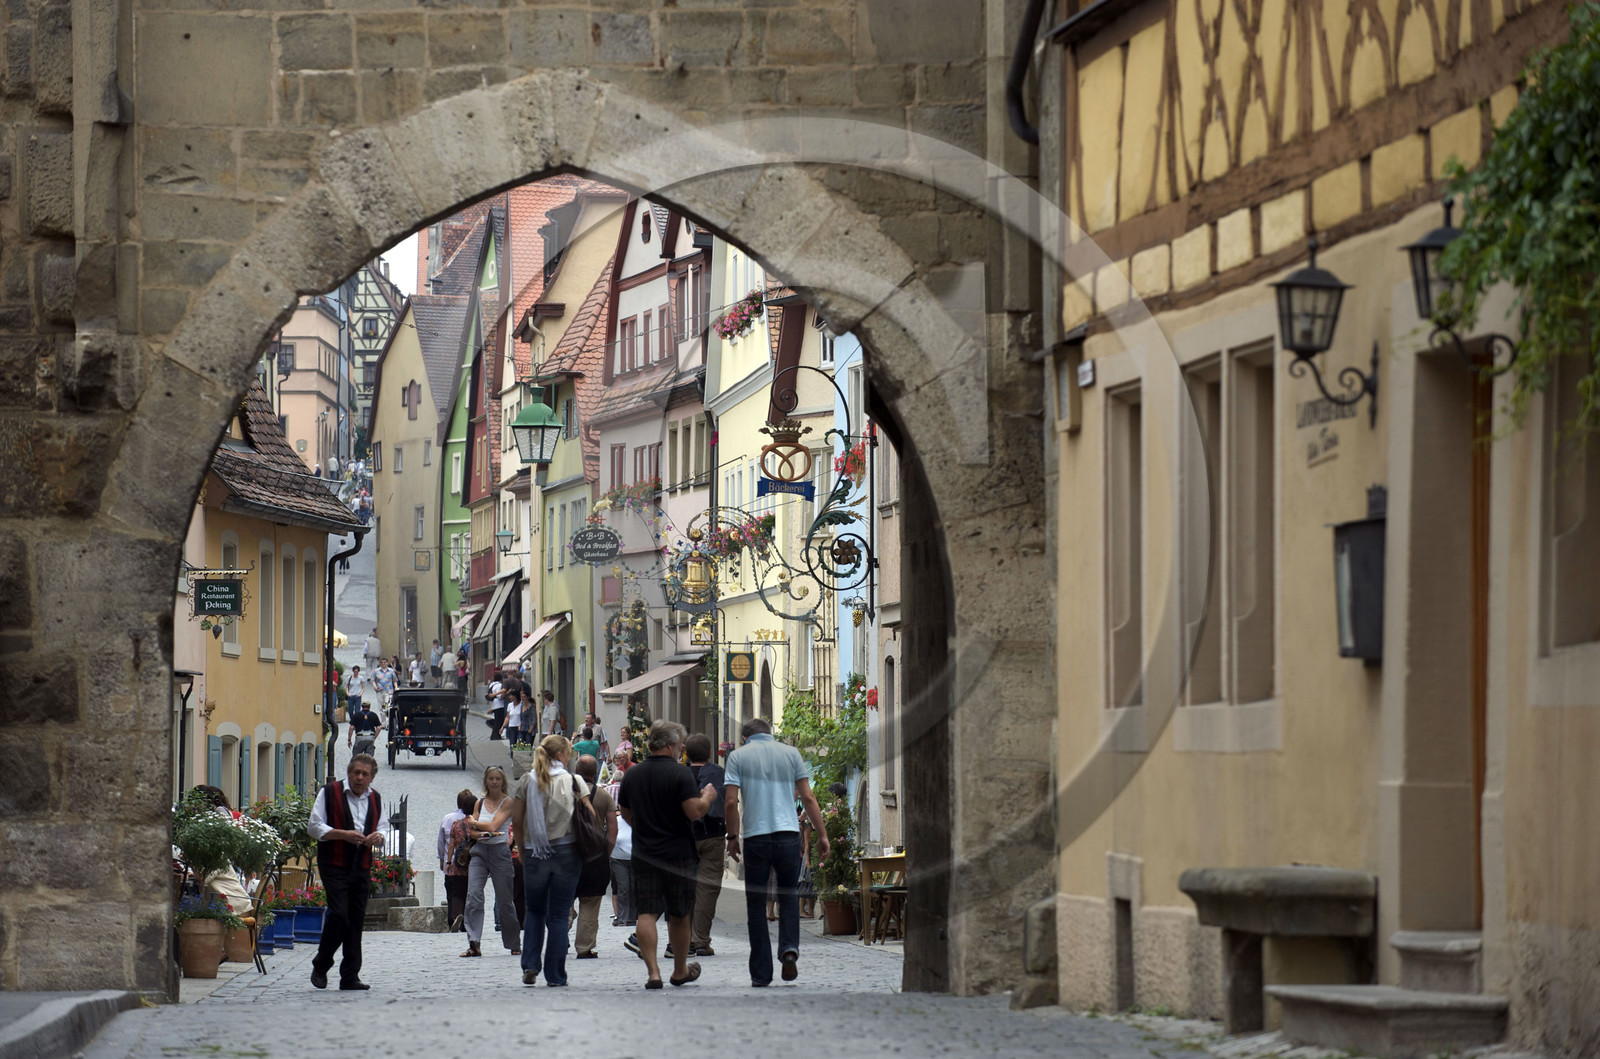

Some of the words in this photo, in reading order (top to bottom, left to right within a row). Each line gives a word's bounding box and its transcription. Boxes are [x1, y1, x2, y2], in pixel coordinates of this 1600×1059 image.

[768, 481, 805, 493] Bäckerei
[592, 541, 617, 550] Breakfast
[205, 600, 232, 610] Peking
